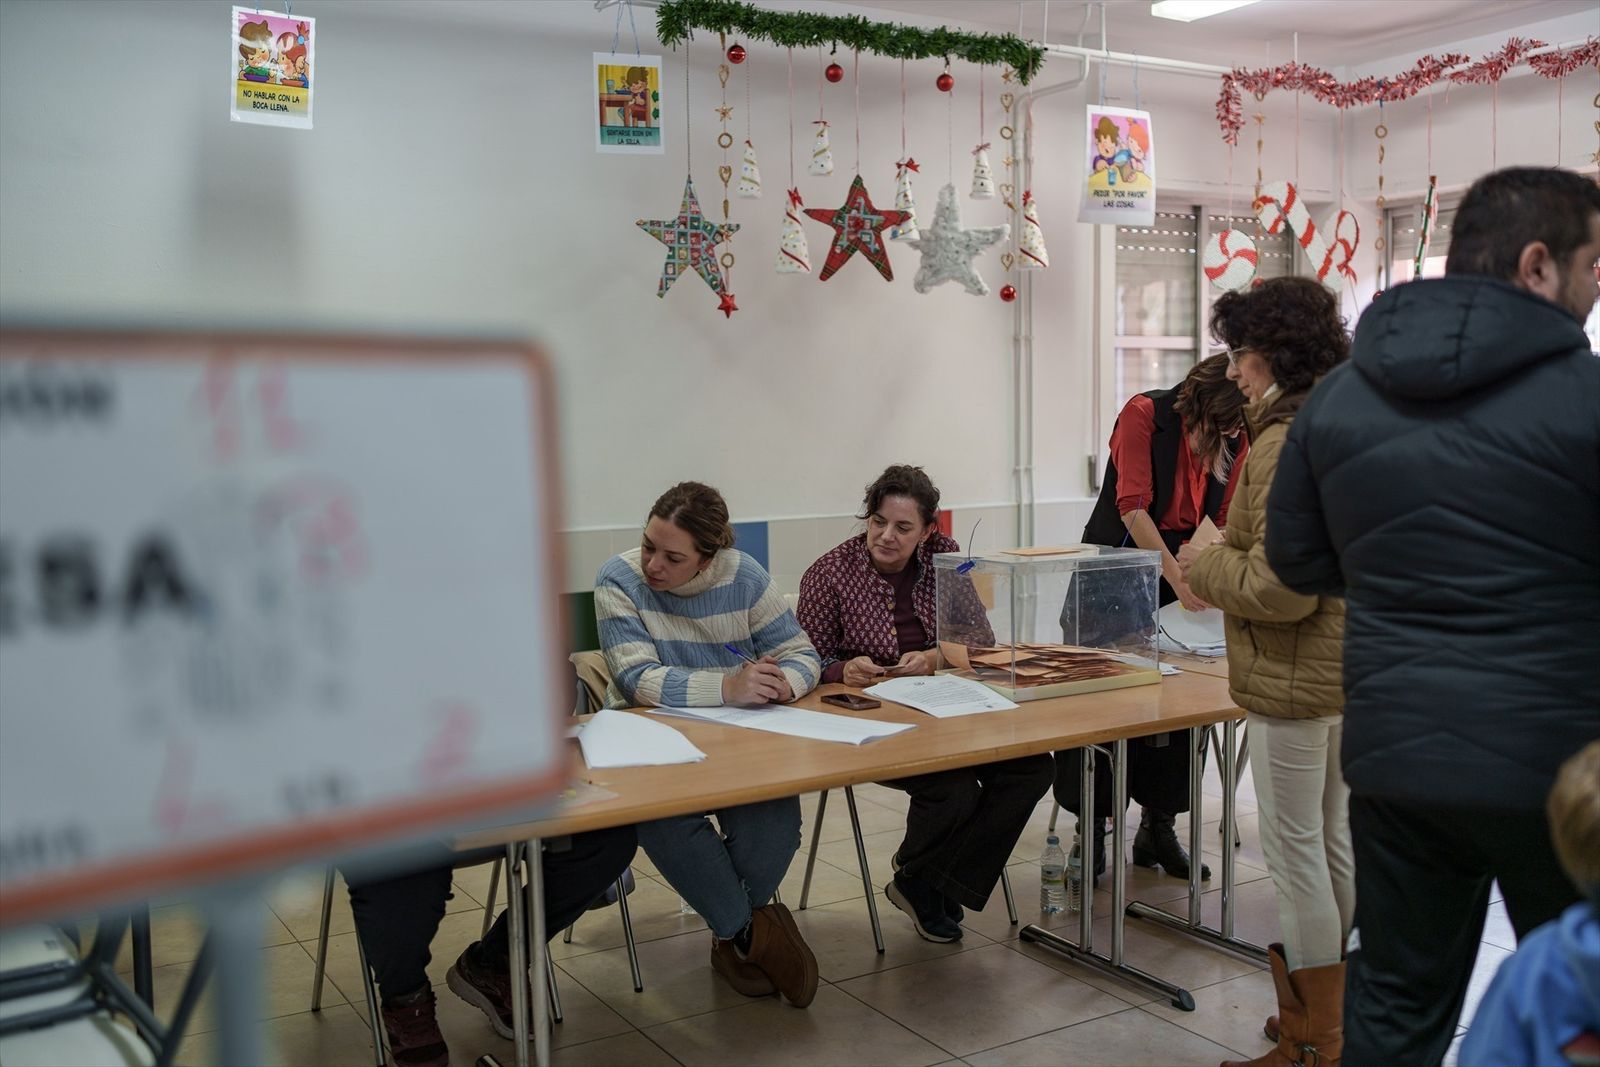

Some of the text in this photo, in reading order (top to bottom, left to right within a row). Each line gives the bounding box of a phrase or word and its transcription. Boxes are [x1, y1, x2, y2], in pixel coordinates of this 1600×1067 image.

[254, 91, 276, 101] HABLAR
[278, 94, 291, 103] CON
[252, 101, 268, 109] BOCA
[1093, 189, 1110, 197] PEDIR
[1103, 200, 1114, 208] LAS
